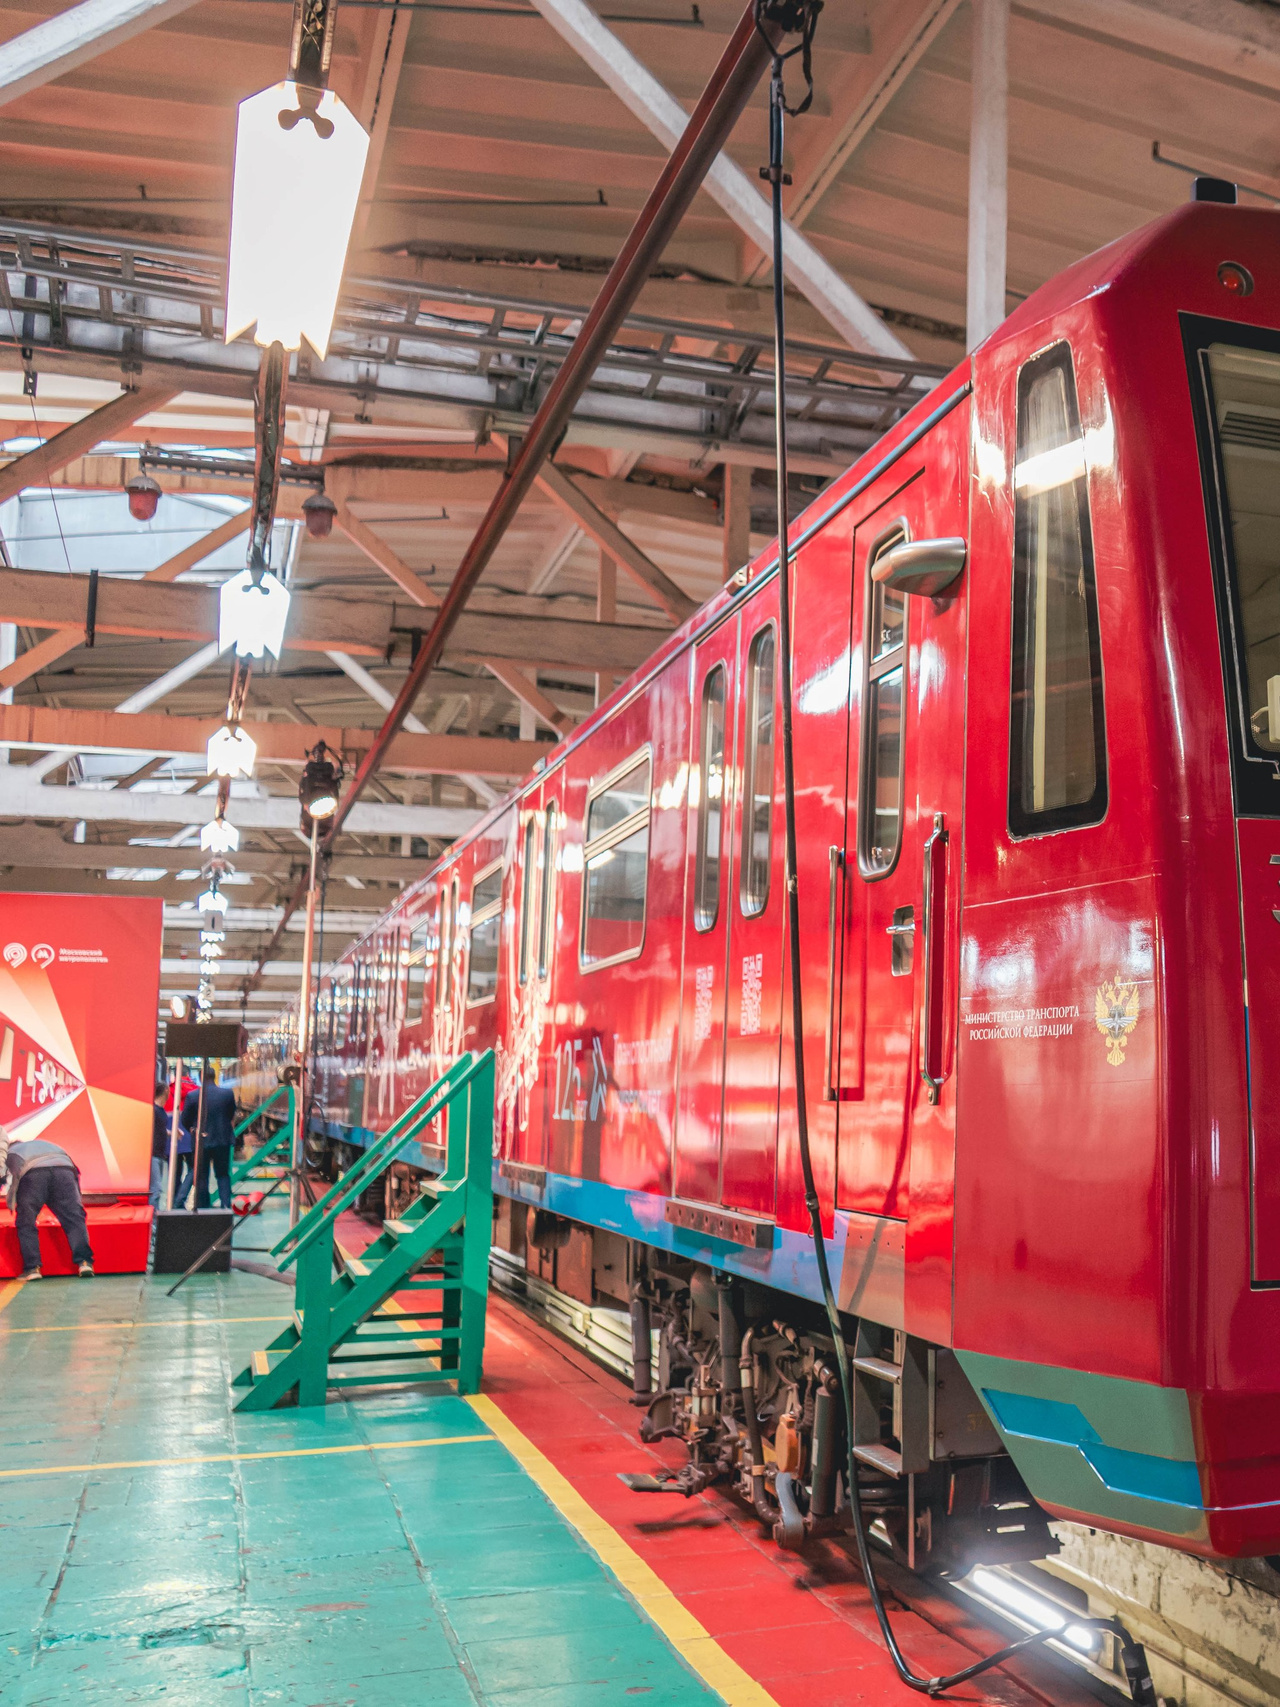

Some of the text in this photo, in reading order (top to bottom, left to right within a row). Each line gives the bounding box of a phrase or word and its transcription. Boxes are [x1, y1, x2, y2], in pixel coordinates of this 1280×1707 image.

[965, 1005, 1080, 1025] МИНИСТЕРСТВО ТРАНСПОРТА
[969, 1023, 1073, 1041] РОССИЙСКОЙ ФЕДЕРАЦИИ
[552, 1039, 582, 1121] 125
